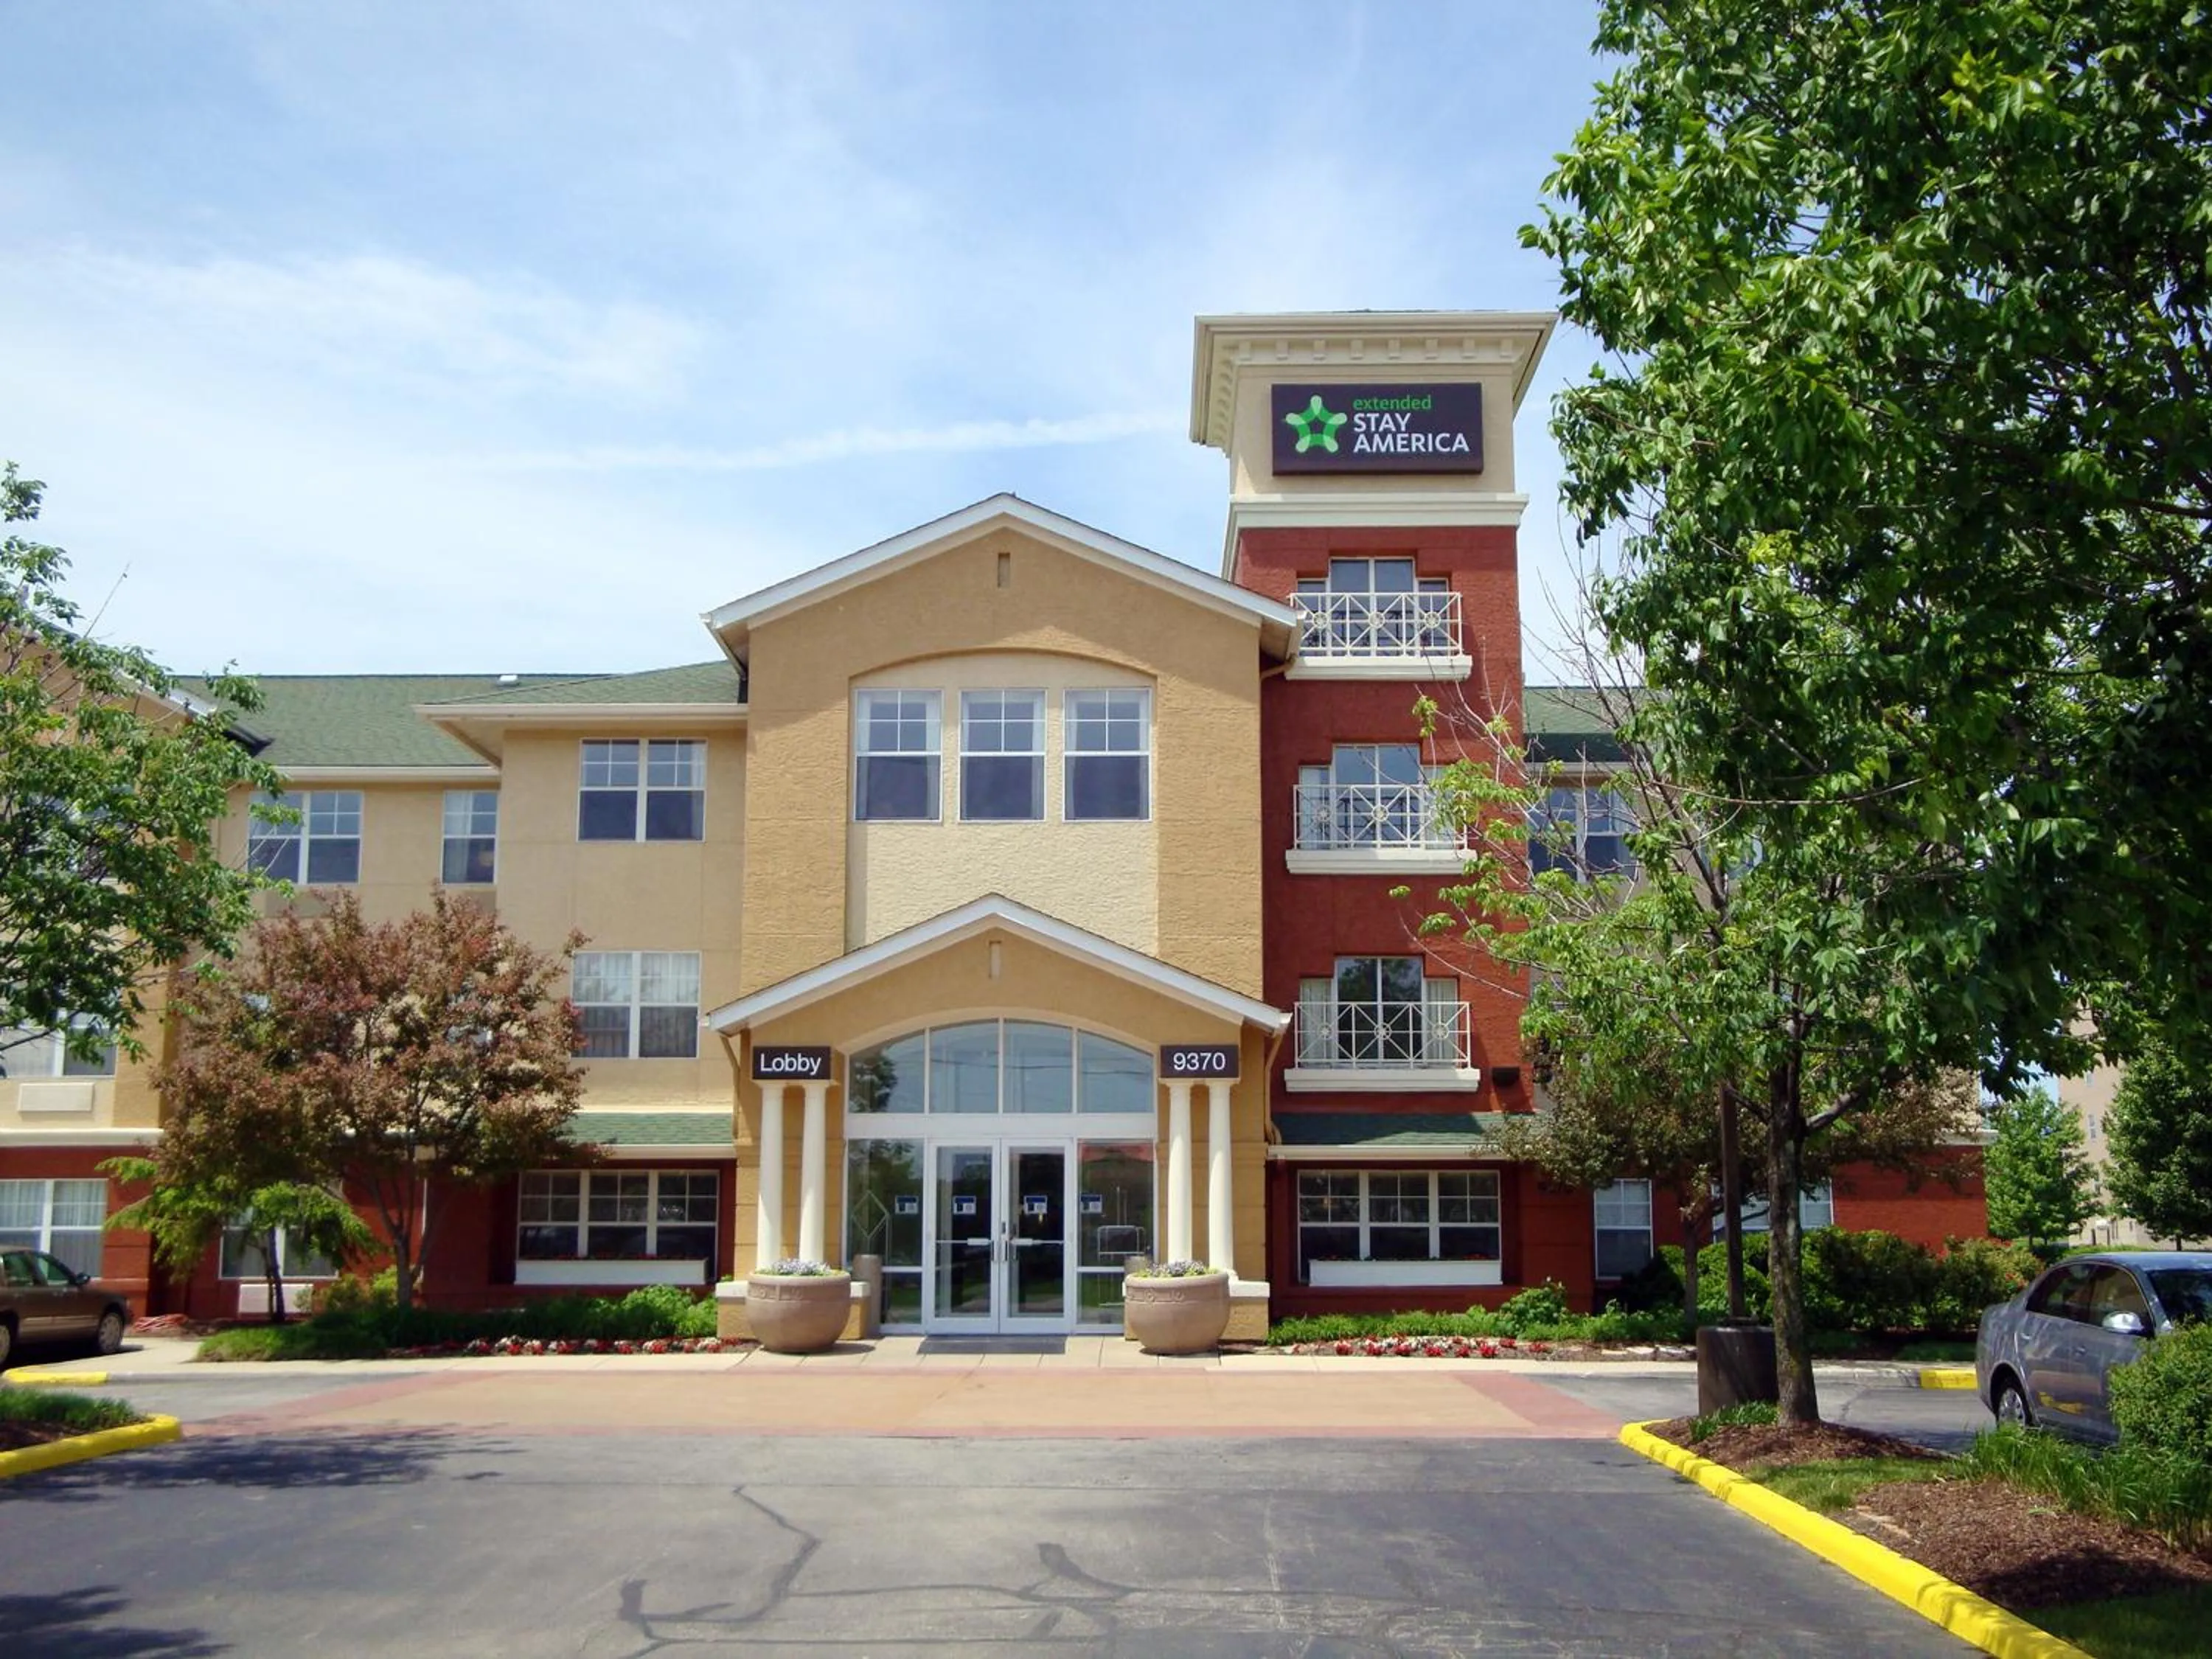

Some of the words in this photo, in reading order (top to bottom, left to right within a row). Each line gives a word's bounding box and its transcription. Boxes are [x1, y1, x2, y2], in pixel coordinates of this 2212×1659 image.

[1353, 394, 1431, 410] extended
[1353, 413, 1411, 432] STAY
[1353, 433, 1470, 453] AMERICA
[760, 1053, 821, 1076] Lobby
[1173, 1052, 1226, 1071] 9370
